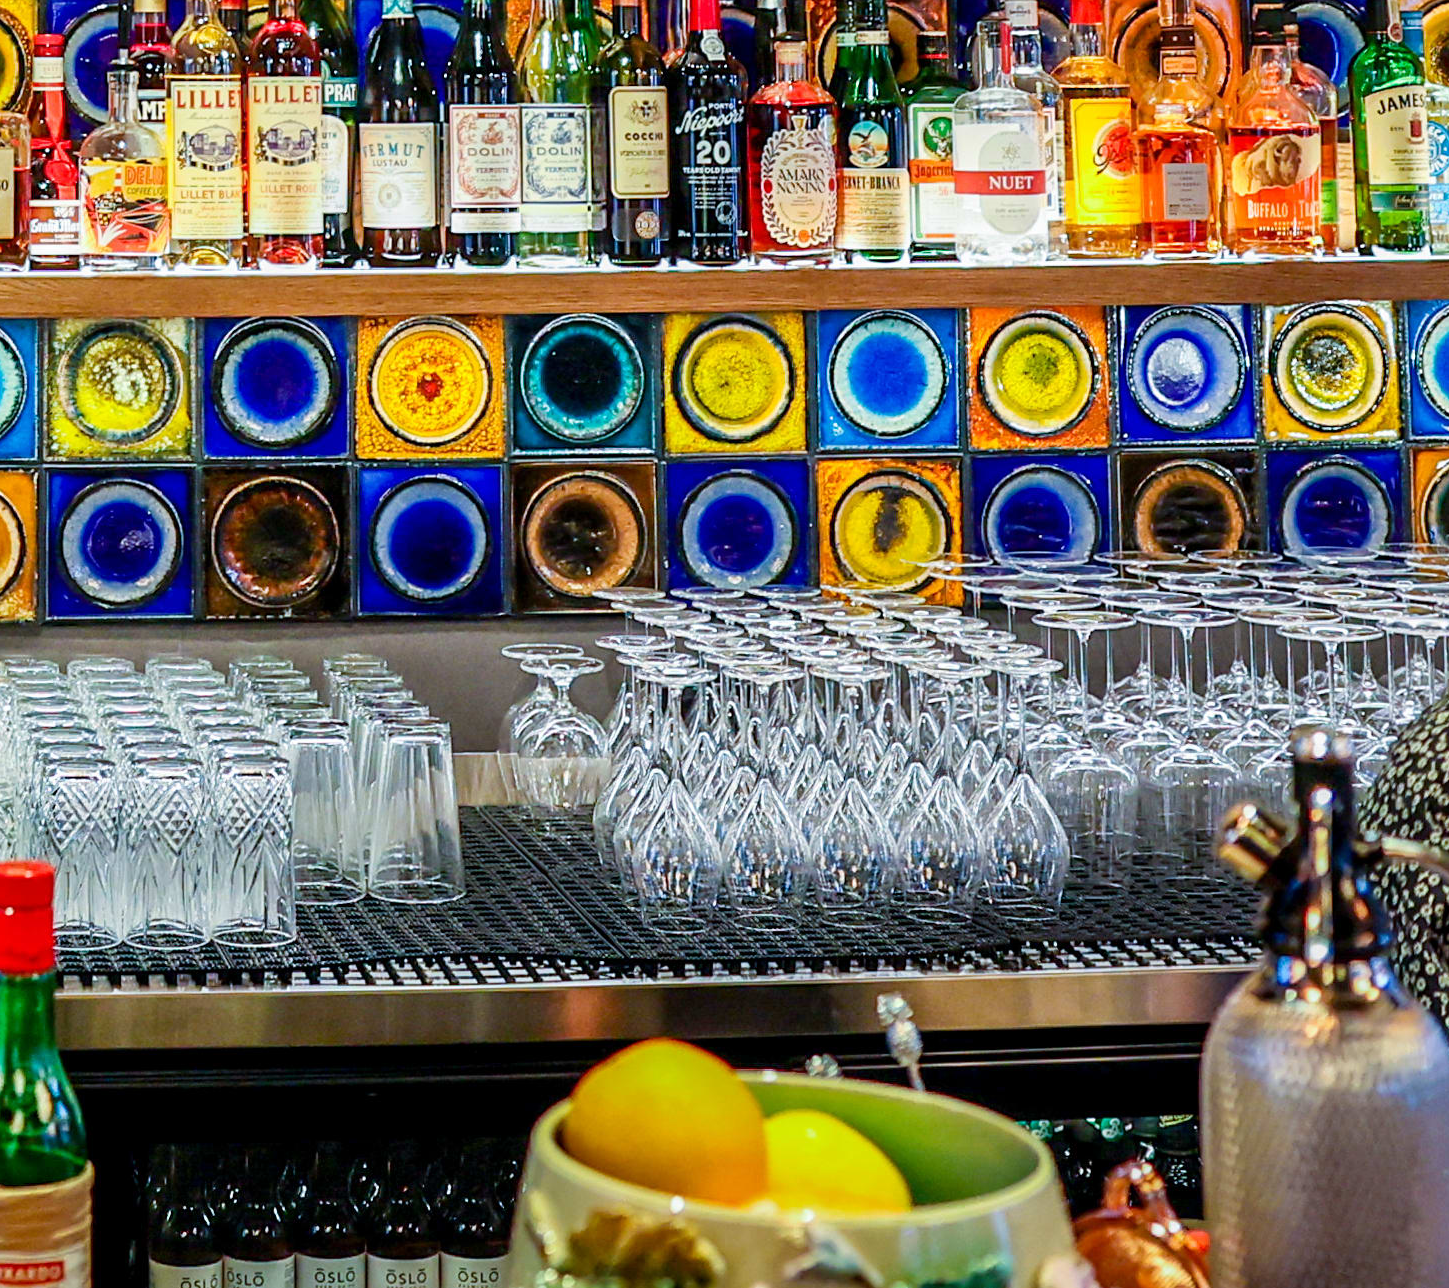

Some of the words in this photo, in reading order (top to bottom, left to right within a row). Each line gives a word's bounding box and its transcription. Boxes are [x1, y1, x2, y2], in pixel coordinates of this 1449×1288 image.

[252, 84, 321, 105] LILLET
[324, 83, 357, 102] PRAT
[708, 102, 734, 110] PORTO
[674, 102, 746, 137] Niepoort
[624, 131, 664, 141] COCCHI
[362, 142, 425, 159] VERMUT
[467, 147, 514, 157] DOLIN
[536, 146, 582, 157] DOLIN
[695, 139, 732, 165] 20
[372, 158, 408, 168] LUSTAU
[778, 167, 825, 181] AMARO
[259, 184, 293, 194] LILLET
[777, 182, 826, 194] NONINO
[988, 175, 1034, 190] NUET
[180, 190, 215, 200] LILLET
[1247, 198, 1289, 219] BUFFALO
